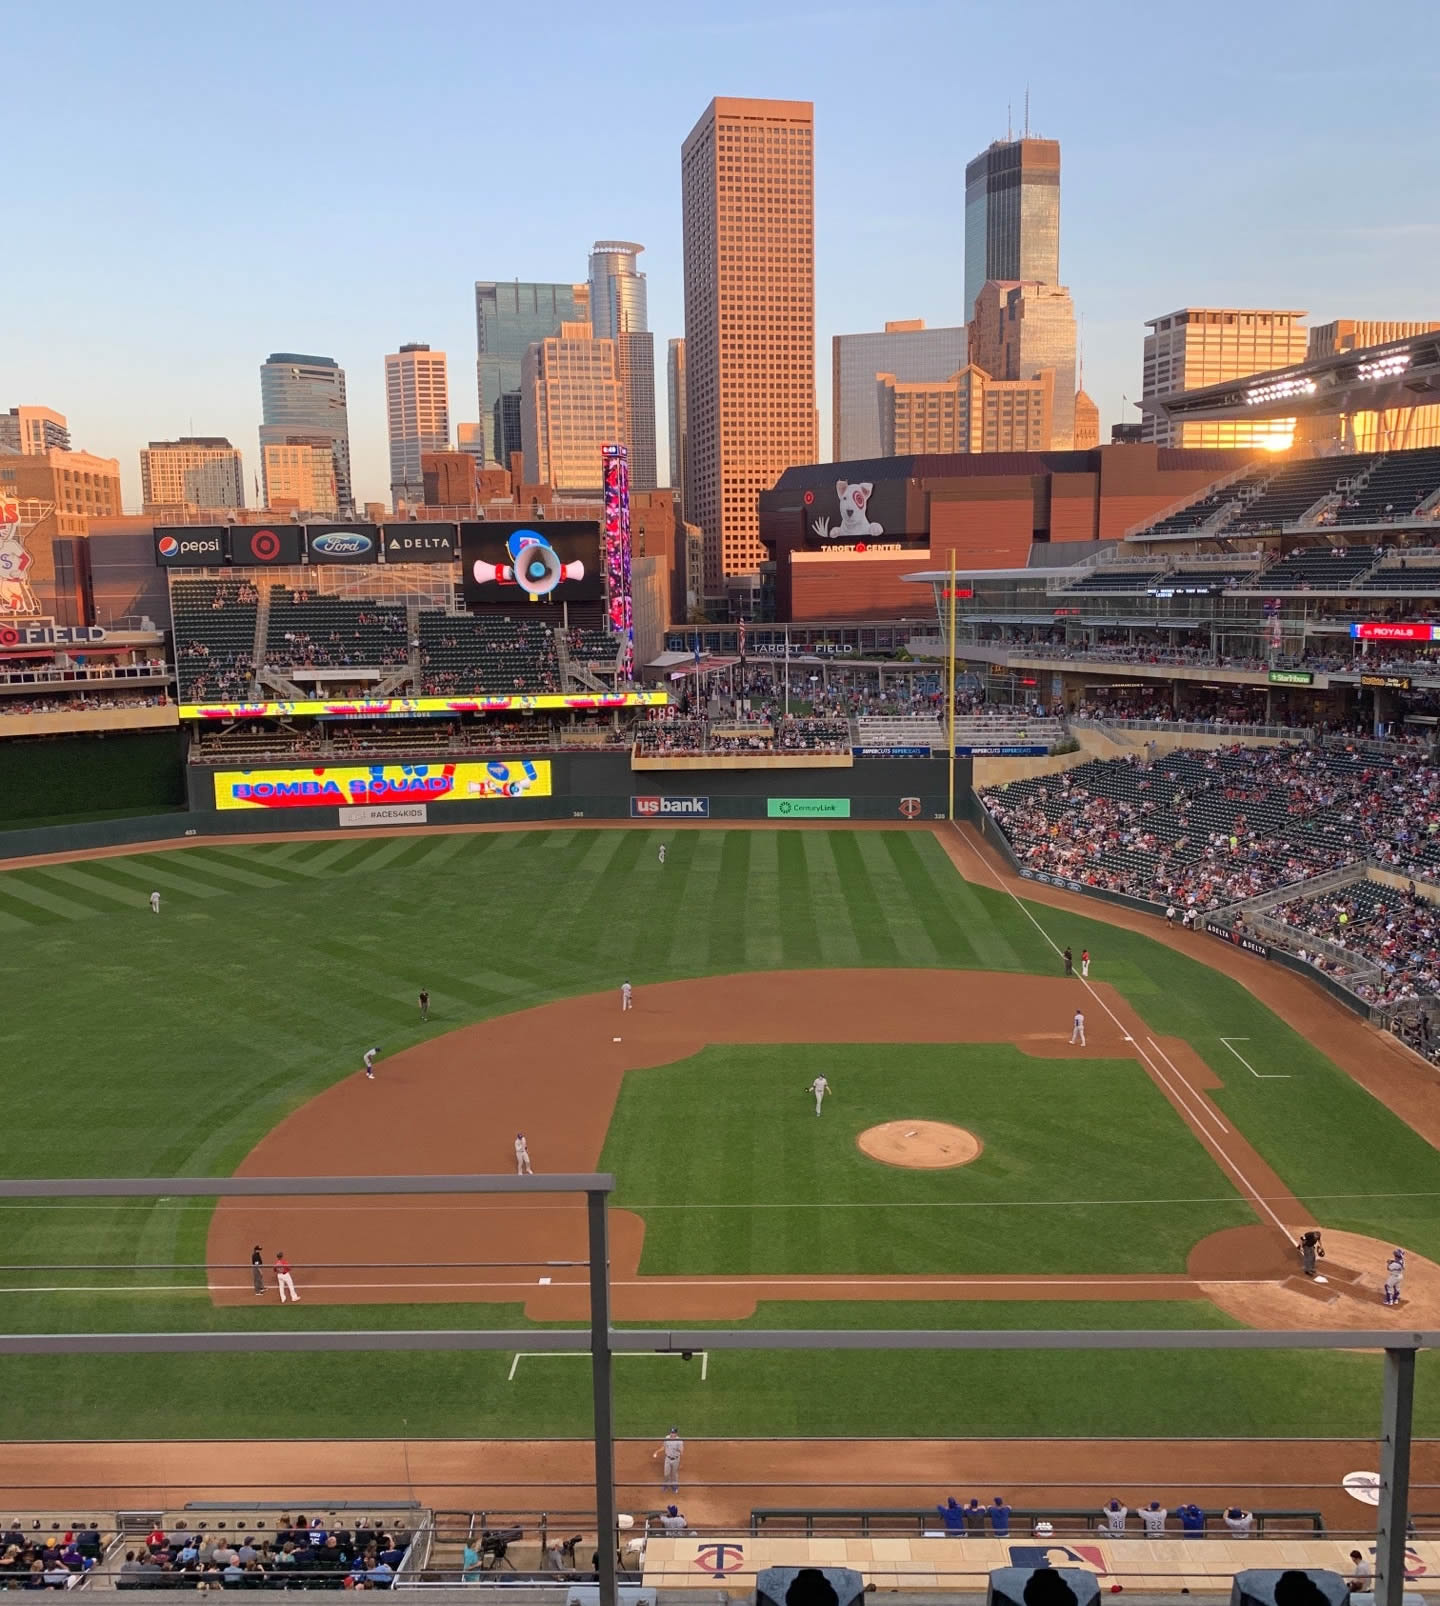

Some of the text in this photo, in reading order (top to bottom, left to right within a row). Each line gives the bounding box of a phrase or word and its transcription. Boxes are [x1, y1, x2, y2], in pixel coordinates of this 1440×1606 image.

[181, 539, 219, 554] pepsi
[324, 537, 360, 552] Ford
[404, 538, 450, 549] DELTA
[866, 544, 902, 552] CENTER
[27, 626, 105, 644] FIELD
[1374, 628, 1414, 637] ROYALS
[753, 644, 853, 653] TARGET FIELD
[232, 777, 454, 799] BOMBA SQUAD!
[793, 803, 837, 813] CenturyLink
[370, 808, 424, 820] #ACES4KIDS
[1212, 926, 1229, 938] DELTA
[1247, 942, 1266, 955] DELTA
[1112, 1520, 1123, 1529] 40
[1151, 1520, 1162, 1530] 22
